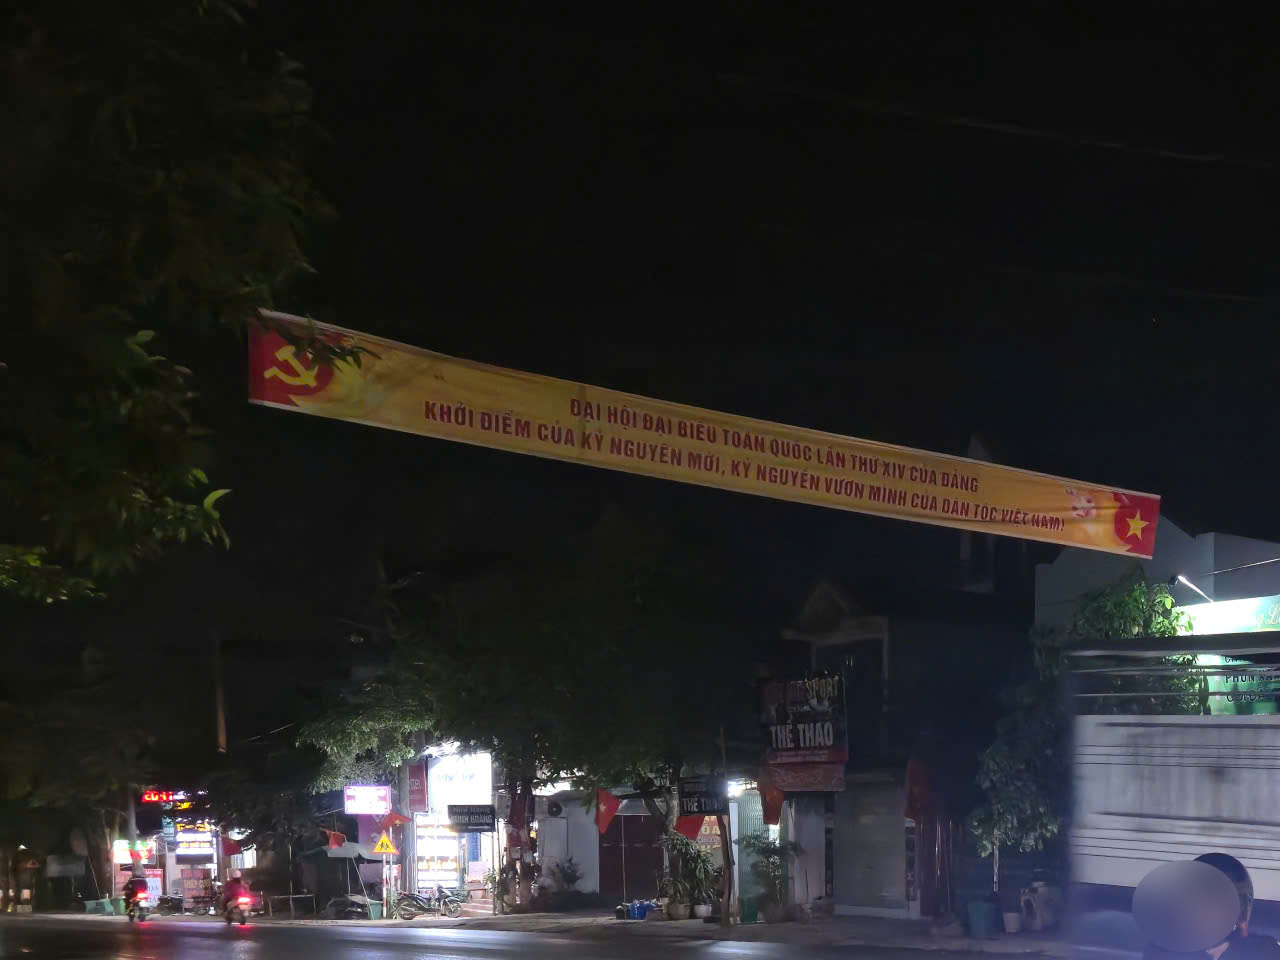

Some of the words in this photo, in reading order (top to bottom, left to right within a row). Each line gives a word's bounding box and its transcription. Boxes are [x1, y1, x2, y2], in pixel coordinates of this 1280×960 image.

[570, 398, 601, 423] ĐẠI
[607, 404, 637, 430] HỘI
[642, 414, 672, 437] ĐẠI
[882, 459, 906, 478] XIV
[797, 721, 834, 748] THAO
